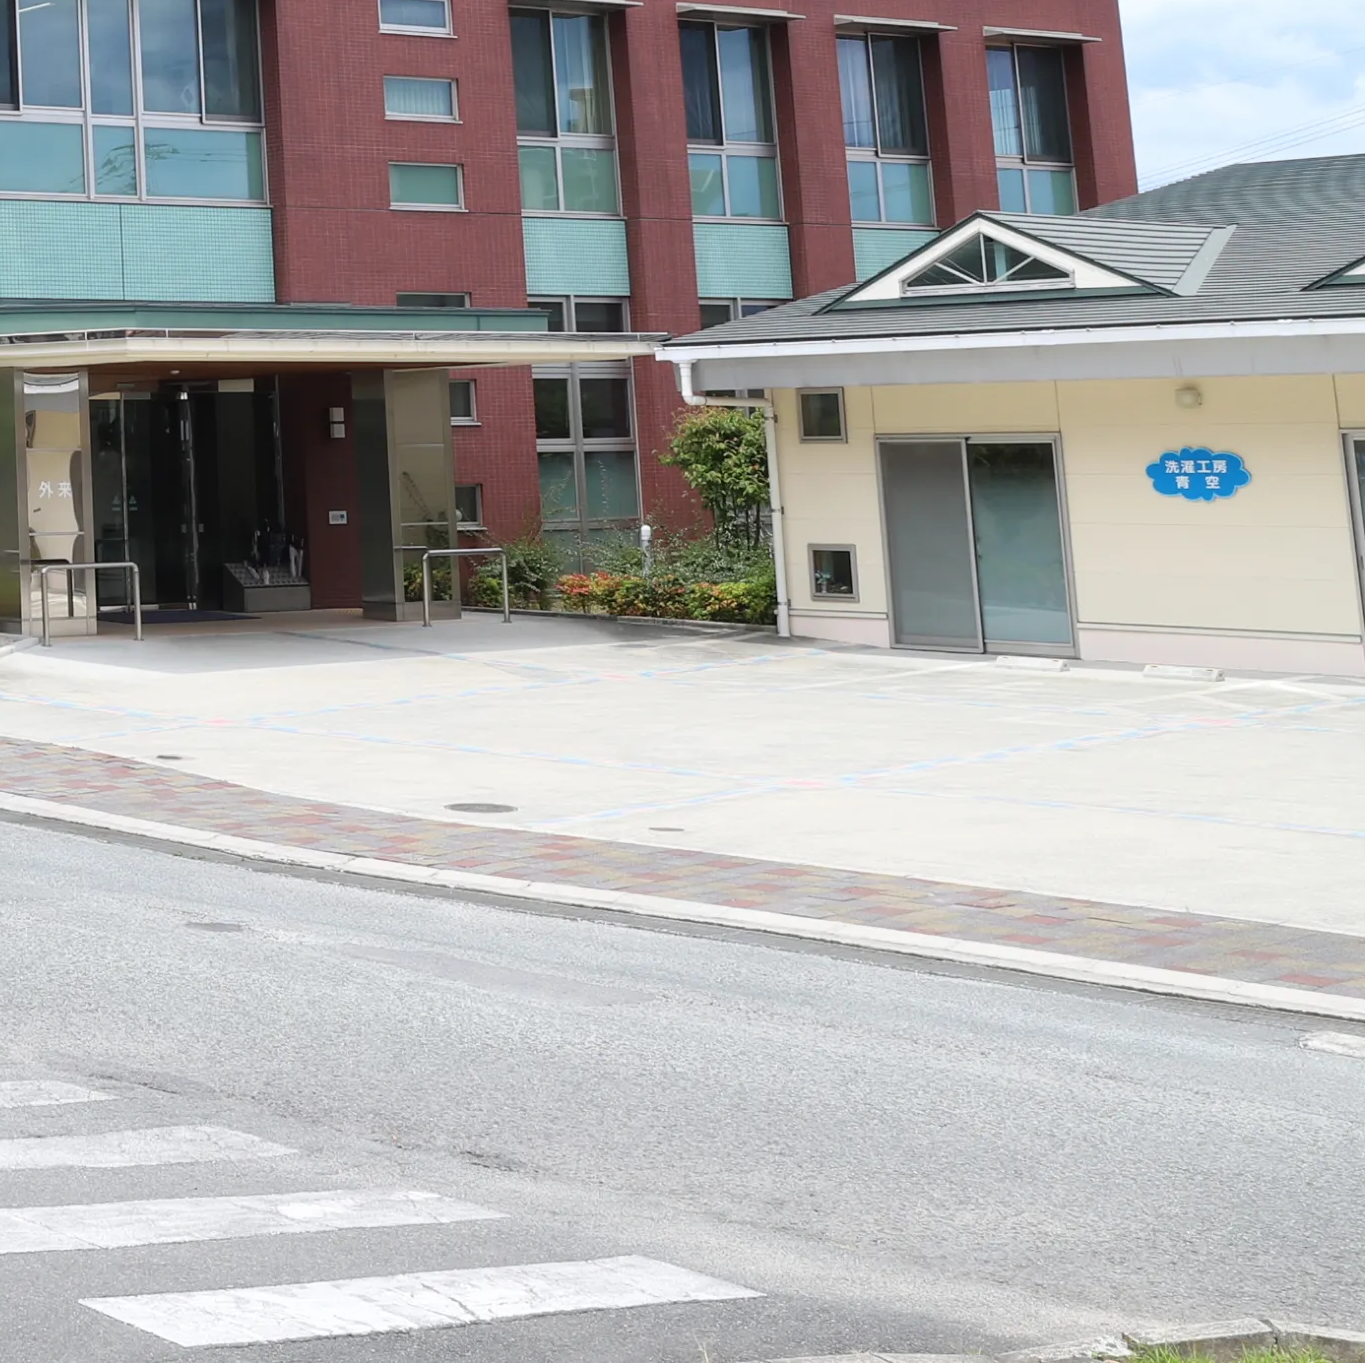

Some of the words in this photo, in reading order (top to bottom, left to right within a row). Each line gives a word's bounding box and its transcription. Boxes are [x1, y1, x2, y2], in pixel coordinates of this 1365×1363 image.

[1165, 460, 1227, 473] 洗濯工房
[39, 481, 72, 497] 外来
